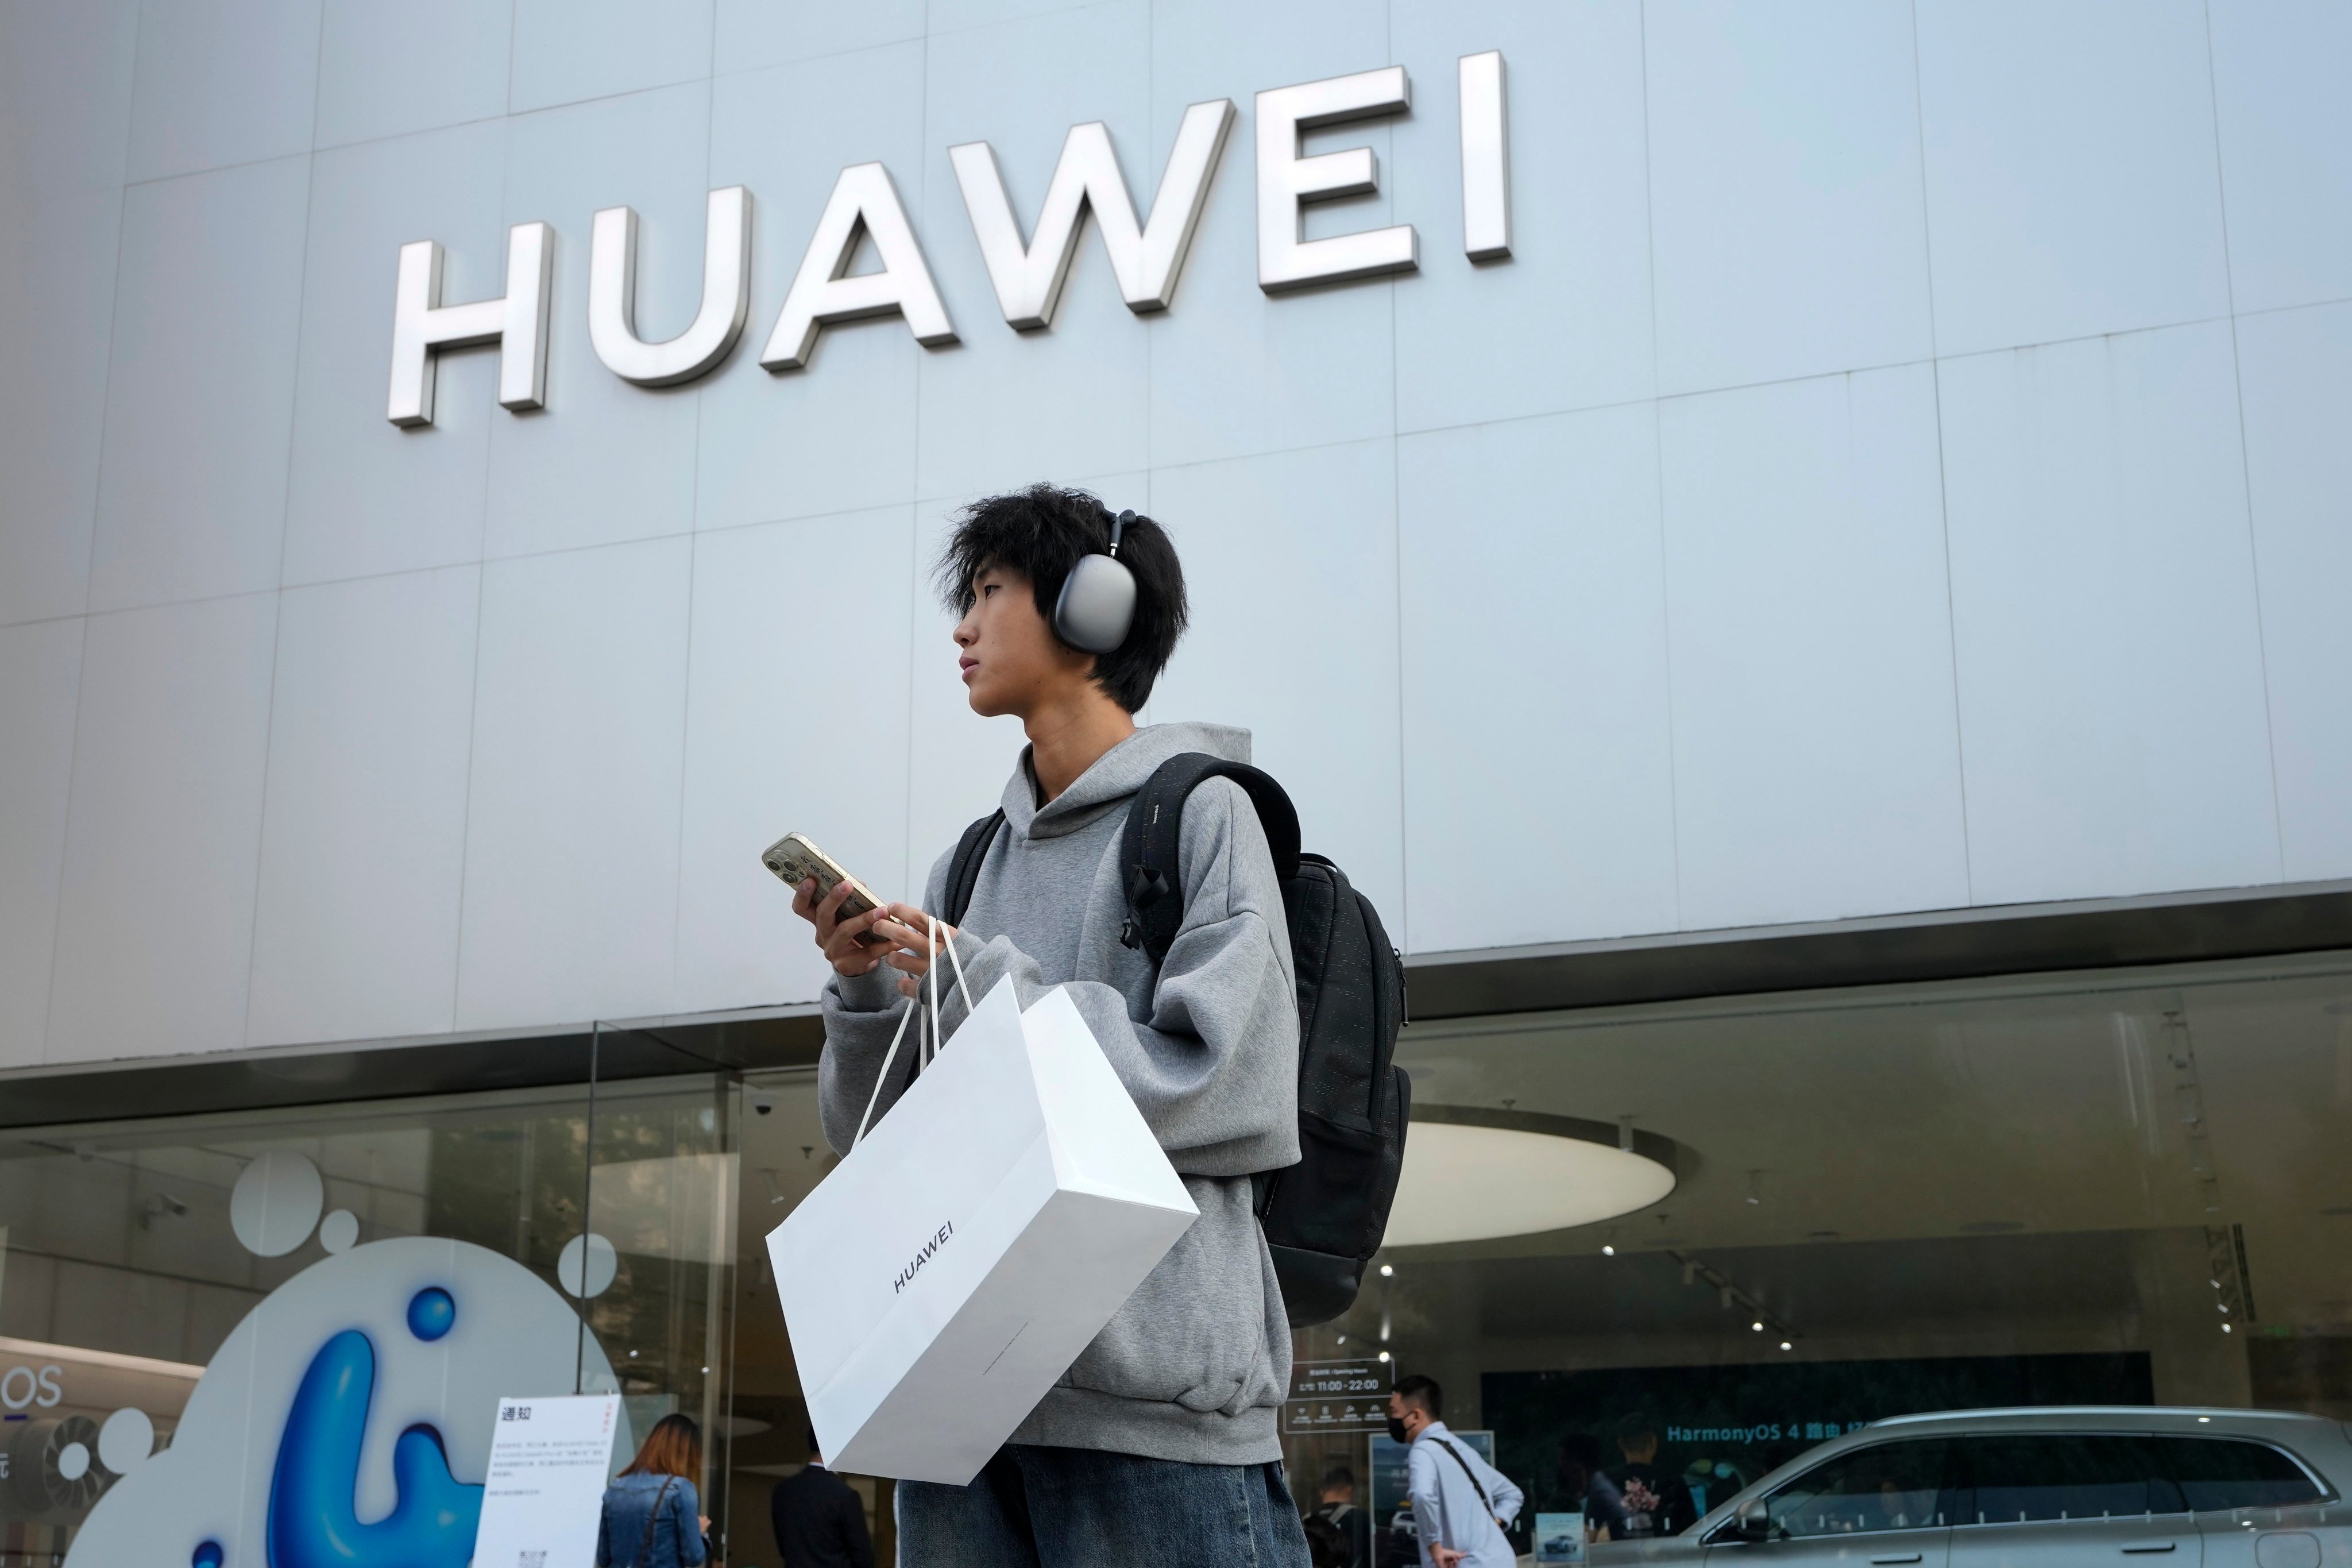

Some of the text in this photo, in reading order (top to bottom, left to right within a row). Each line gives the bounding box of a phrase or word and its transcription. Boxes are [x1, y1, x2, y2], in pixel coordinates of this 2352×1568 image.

[387, 49, 1515, 428] HUAWEI
[894, 1220, 953, 1294] HUAWEI
[1, 1364, 63, 1410] OS
[501, 1407, 532, 1422] 通知
[1667, 1424, 1781, 1445] HarmonyOS
[1787, 1424, 1799, 1440] 4
